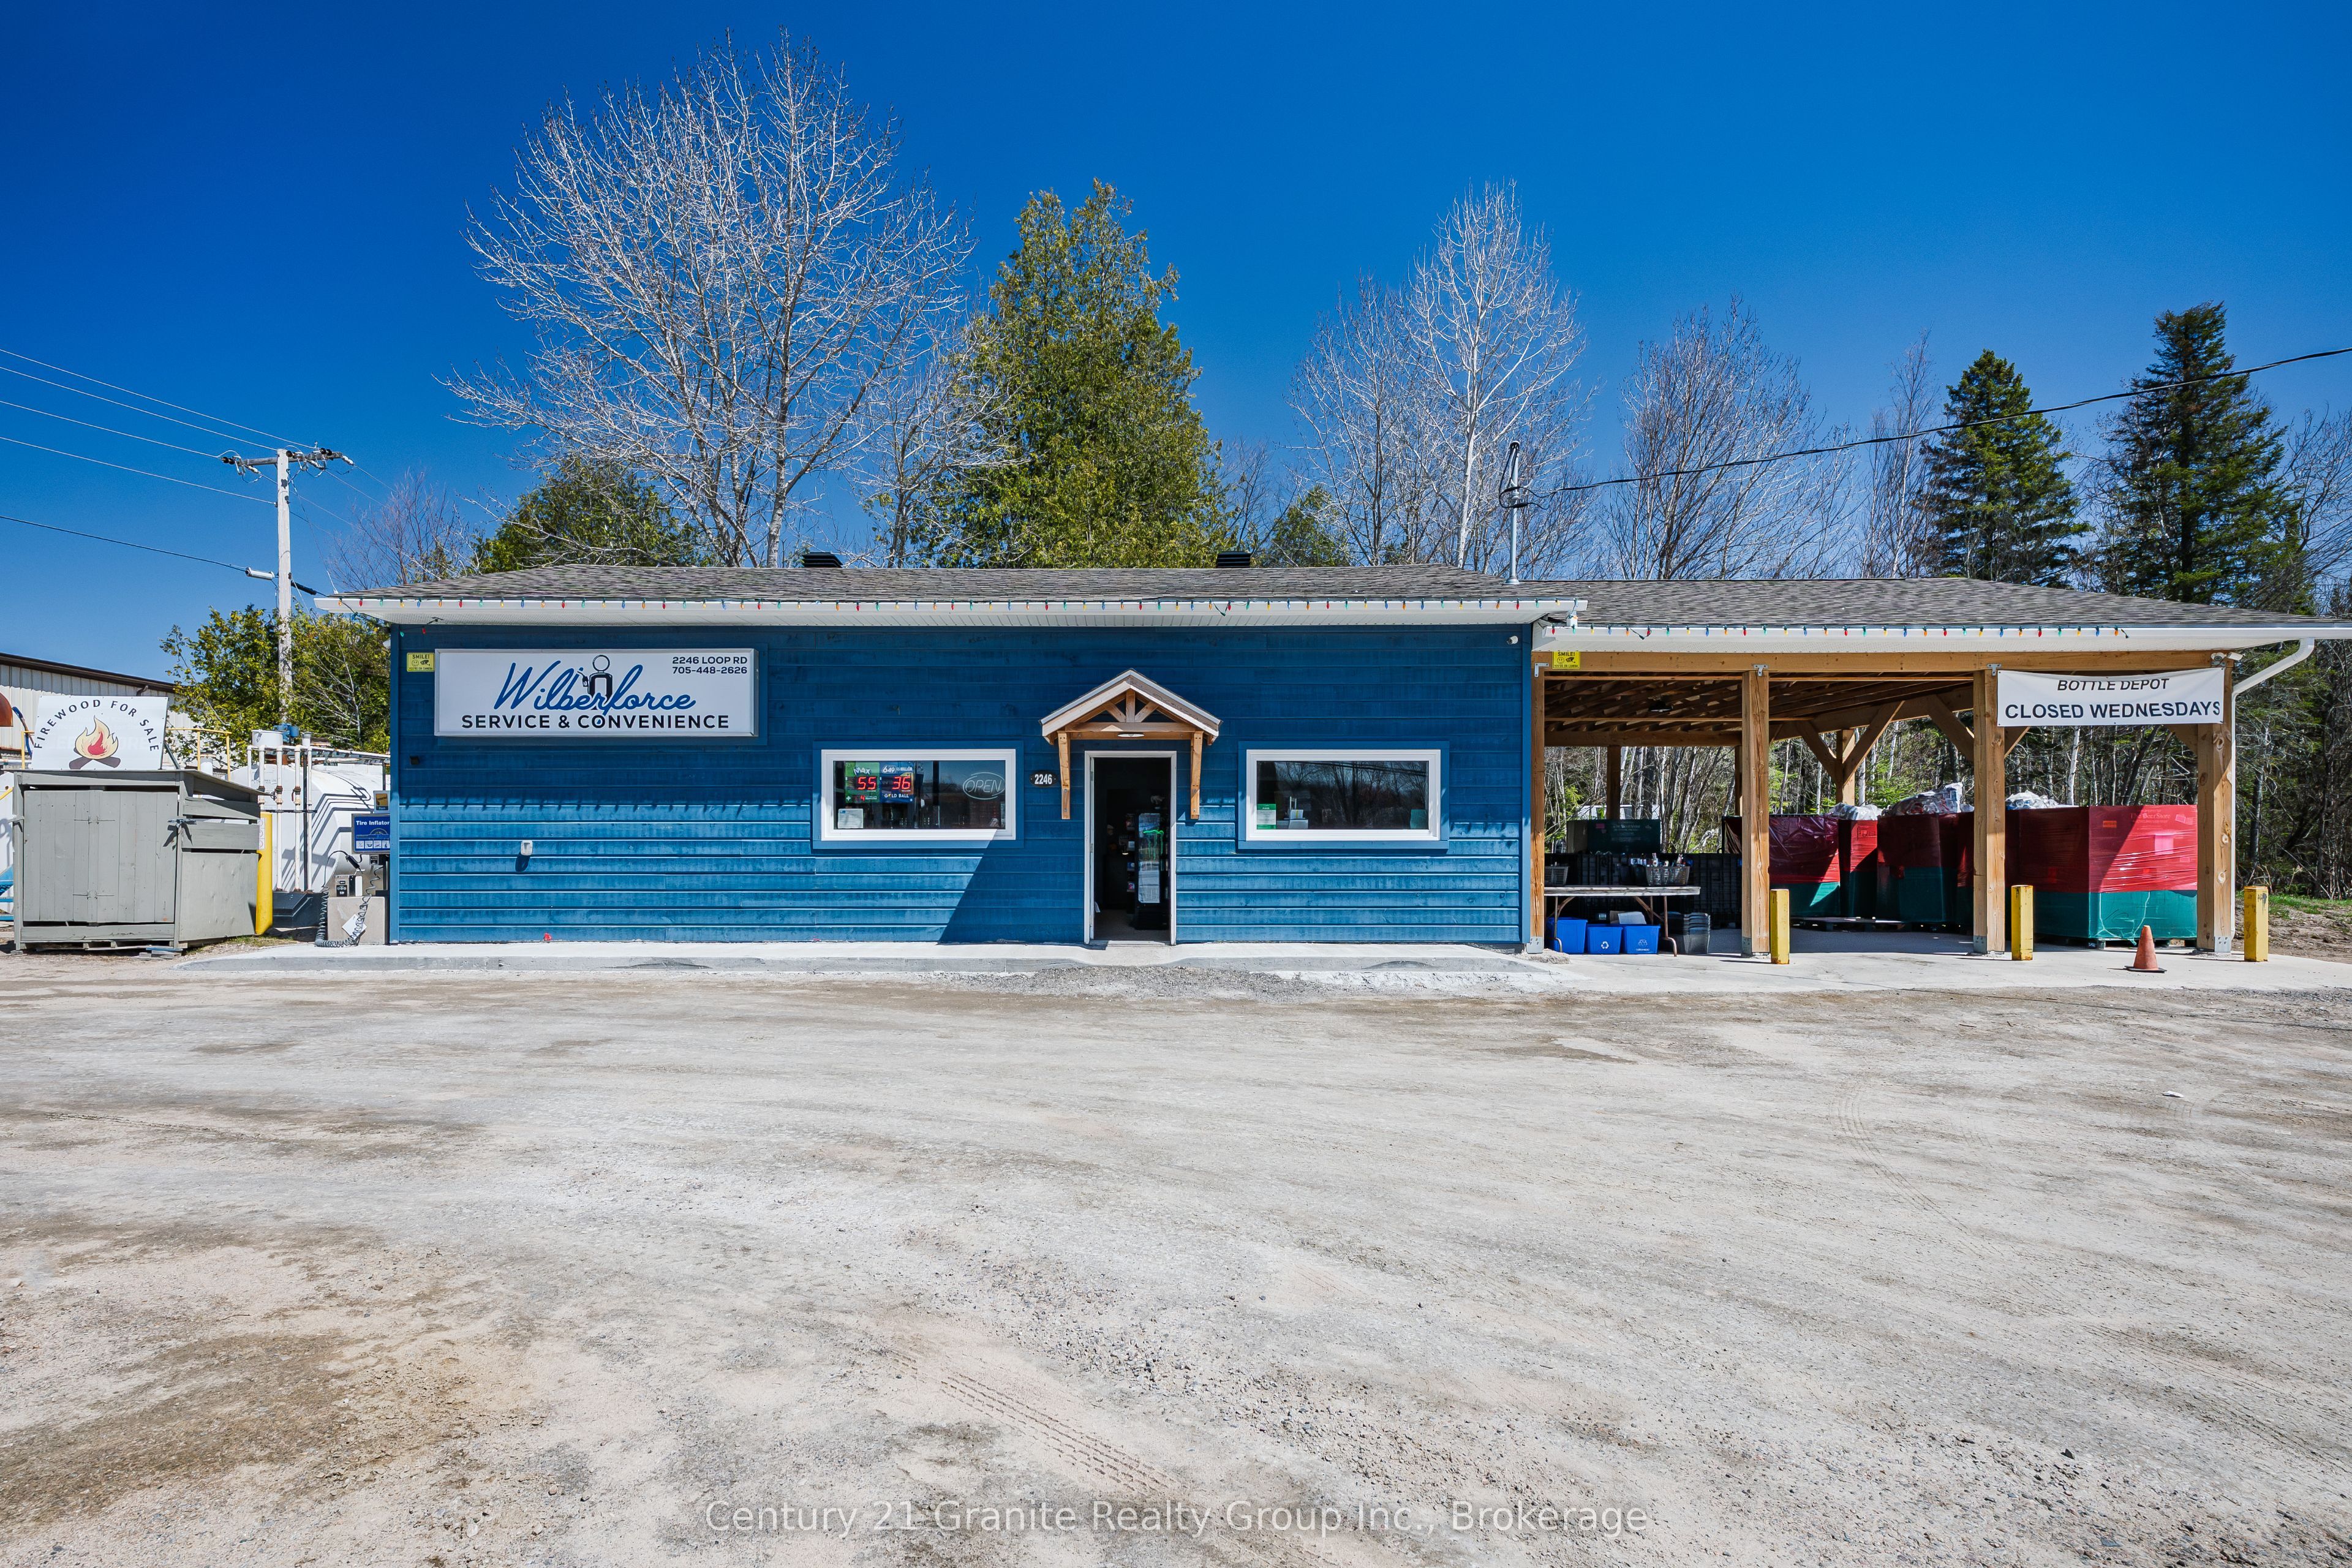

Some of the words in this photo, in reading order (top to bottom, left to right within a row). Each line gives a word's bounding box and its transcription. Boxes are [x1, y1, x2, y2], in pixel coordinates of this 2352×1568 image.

[493, 660, 696, 716] Wilberforce
[2057, 679, 2116, 691] BOTTLE
[2120, 678, 2169, 691] DEPOT
[2005, 704, 2084, 719] CLOSED
[2089, 701, 2220, 718] WEDNESDAYS
[34, 699, 100, 748] FIREWOOD
[110, 700, 137, 717] FOR
[140, 719, 159, 752] SALE
[461, 714, 550, 729] SERVICE
[558, 714, 570, 729] &
[578, 714, 729, 729] CONVENIENCE
[853, 767, 870, 775] MAX
[858, 776, 877, 790] 55
[892, 775, 911, 790] 36
[965, 779, 1002, 794] OPEN
[1034, 774, 1052, 785] 2246
